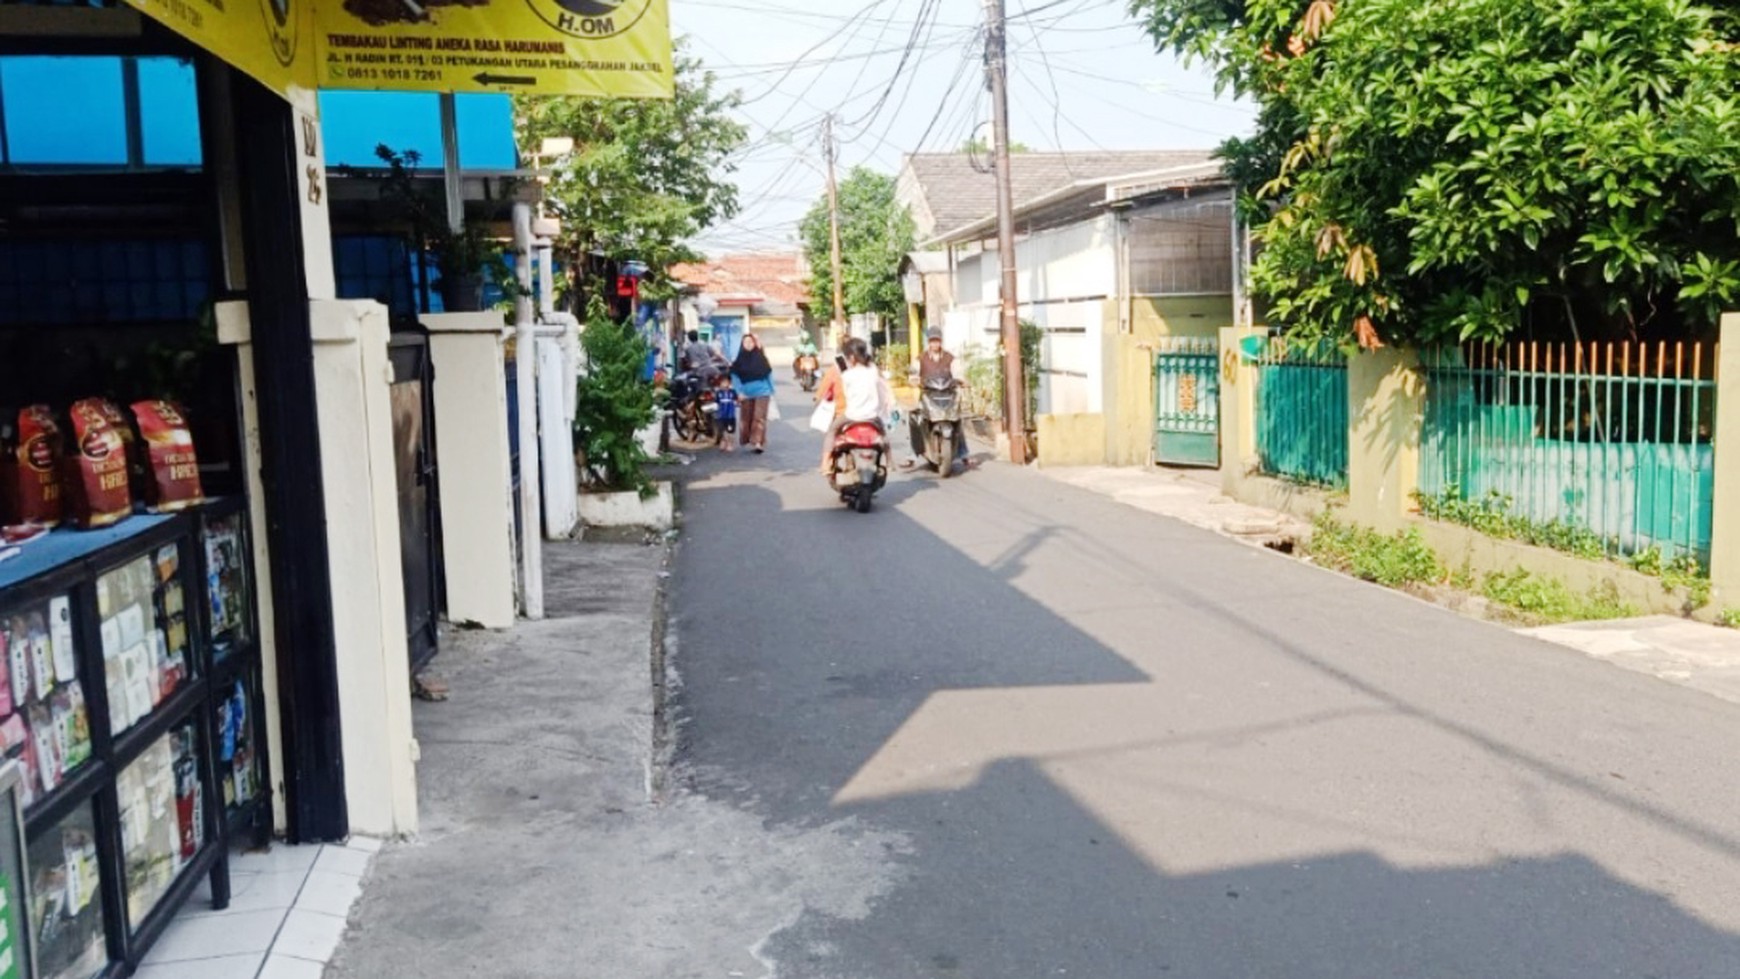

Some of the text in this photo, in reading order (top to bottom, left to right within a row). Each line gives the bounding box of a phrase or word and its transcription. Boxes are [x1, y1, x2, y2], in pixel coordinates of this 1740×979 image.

[558, 12, 615, 34] H.OM
[327, 34, 565, 54] TEMBAKAU LINTING ANEKA RASA HARUMANIS
[327, 53, 342, 62] JL.
[355, 53, 386, 64] RADIN
[445, 56, 512, 68] PETUKANGAN
[514, 59, 547, 69] UTARA
[550, 60, 626, 71] PESANGGRAHAN
[347, 67, 442, 81] 0813 1018 7261
